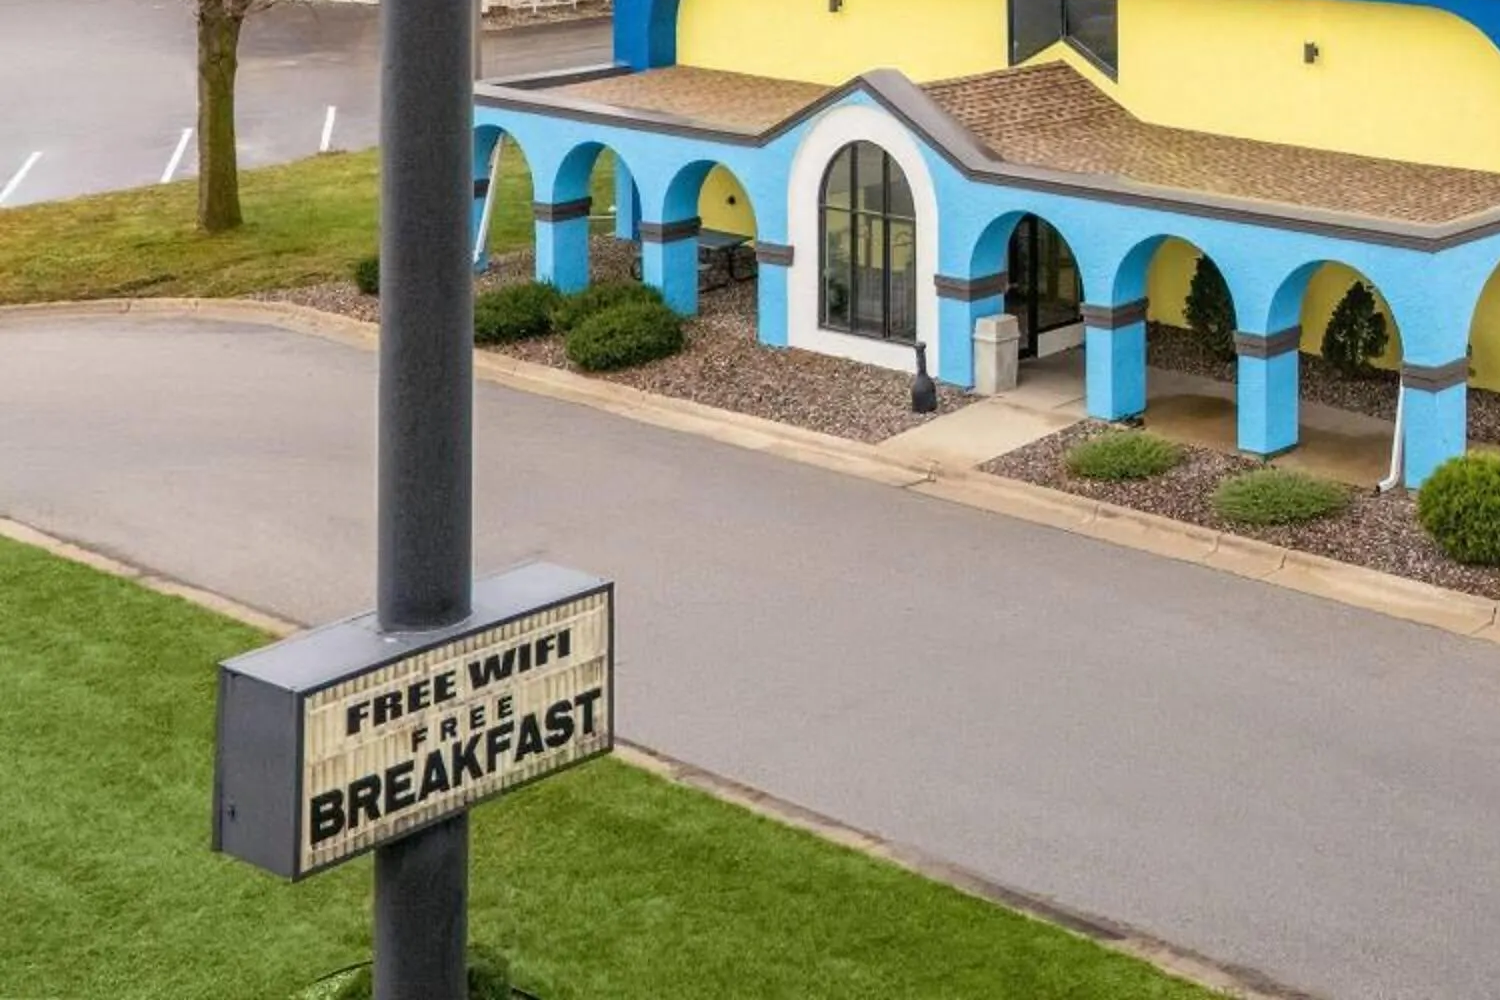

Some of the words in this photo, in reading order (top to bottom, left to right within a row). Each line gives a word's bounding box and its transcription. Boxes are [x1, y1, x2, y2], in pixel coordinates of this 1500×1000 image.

[347, 670, 457, 736] FREE
[468, 628, 571, 690] WIFI
[412, 695, 514, 752] FREE
[310, 689, 602, 846] BREAKFAST
